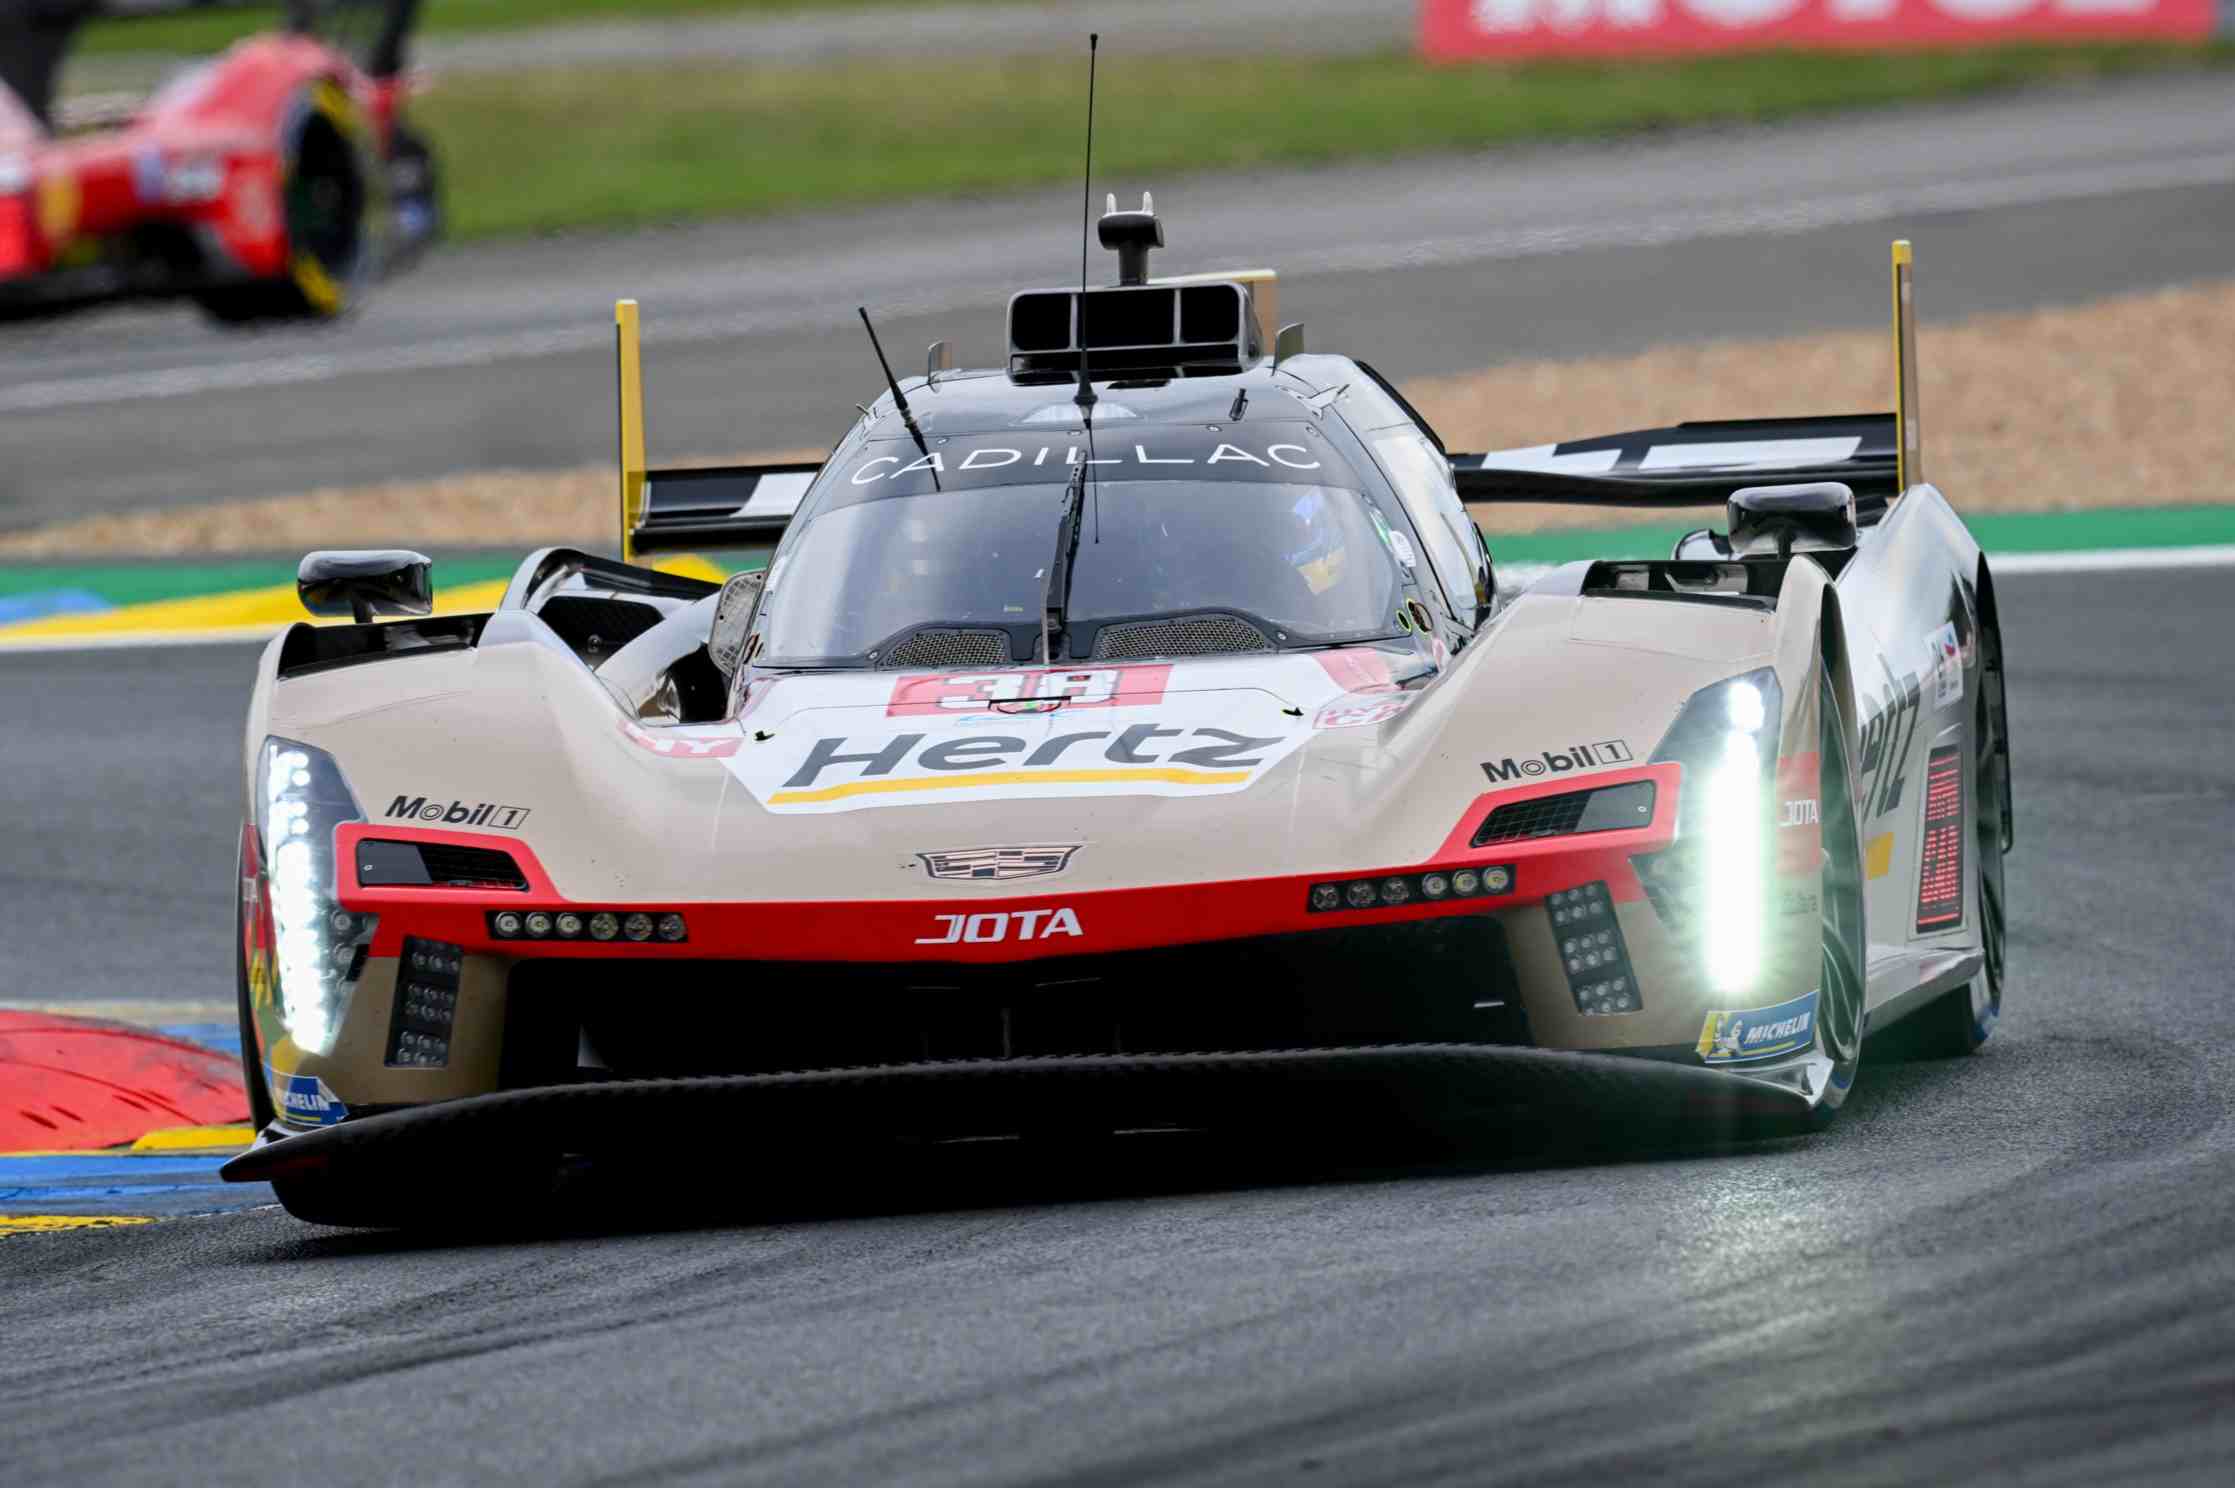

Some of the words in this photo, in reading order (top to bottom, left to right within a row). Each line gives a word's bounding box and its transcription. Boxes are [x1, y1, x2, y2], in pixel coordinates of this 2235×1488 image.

[851, 443, 1321, 485] CADILLAC
[781, 723, 1286, 788] Hertz
[1480, 745, 1597, 783] Mobil
[384, 795, 496, 826] Mobil
[914, 907, 1084, 944] JOTA
[1744, 1011, 1811, 1045] MICHELIN
